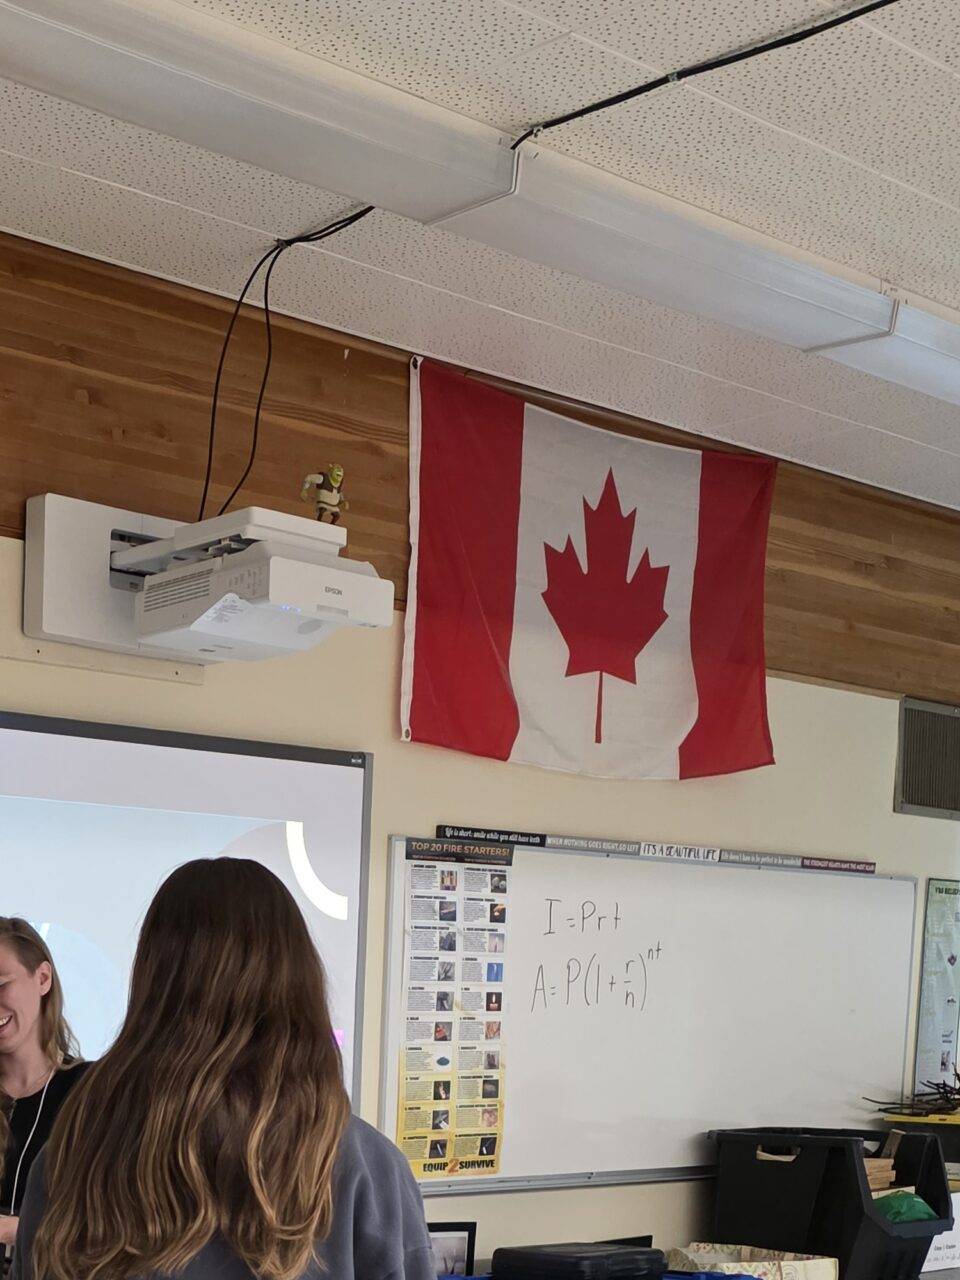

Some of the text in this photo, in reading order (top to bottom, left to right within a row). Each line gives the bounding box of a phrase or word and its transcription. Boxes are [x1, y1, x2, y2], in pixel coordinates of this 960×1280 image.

[411, 841, 509, 857] TOP 20 FIRE STARTERS!
